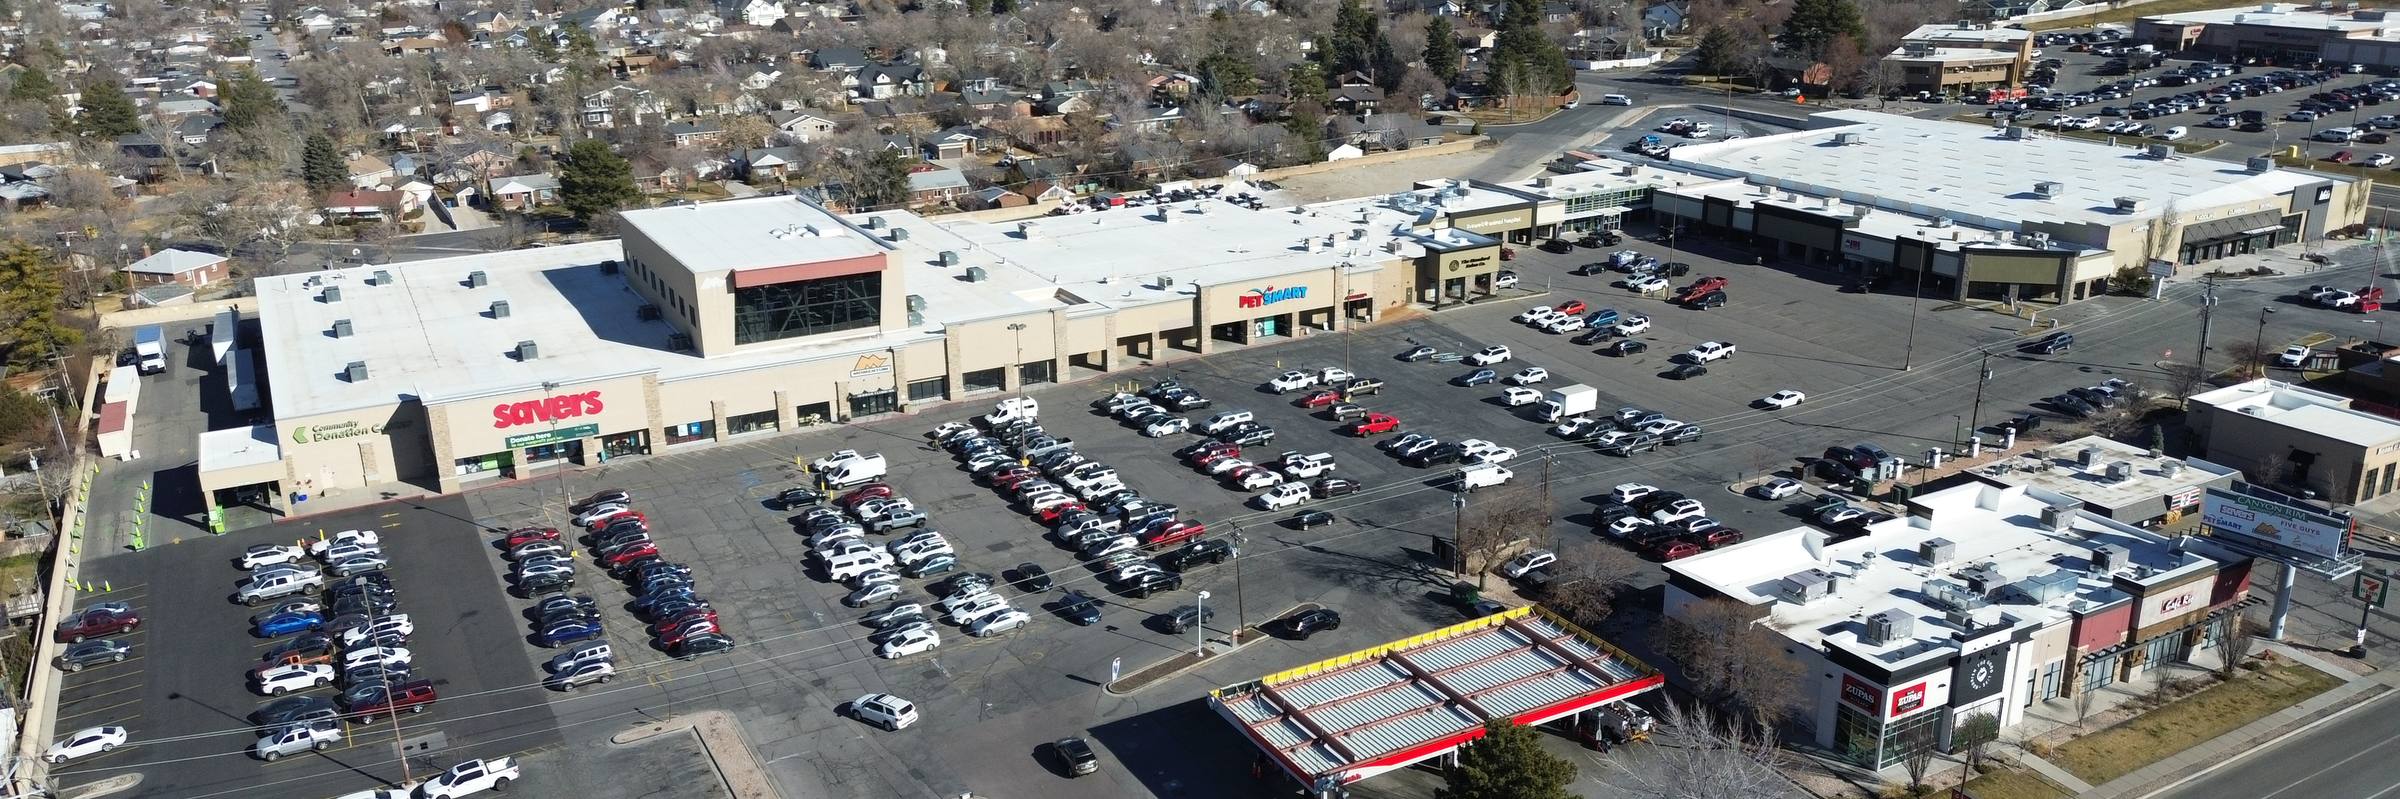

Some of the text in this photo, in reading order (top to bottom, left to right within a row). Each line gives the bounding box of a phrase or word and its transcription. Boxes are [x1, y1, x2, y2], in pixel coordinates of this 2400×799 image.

[494, 391, 604, 429] savers
[312, 420, 359, 433] Community
[313, 427, 369, 443] Donation
[510, 432, 552, 444] Donate here
[2238, 496, 2282, 513] CANYON
[2285, 508, 2306, 520] RIM
[2281, 520, 2298, 530] FIVE
[2299, 524, 2321, 536] GUYS
[1846, 684, 1875, 704] ZUPAS
[1897, 691, 1923, 706] ZUPAS
